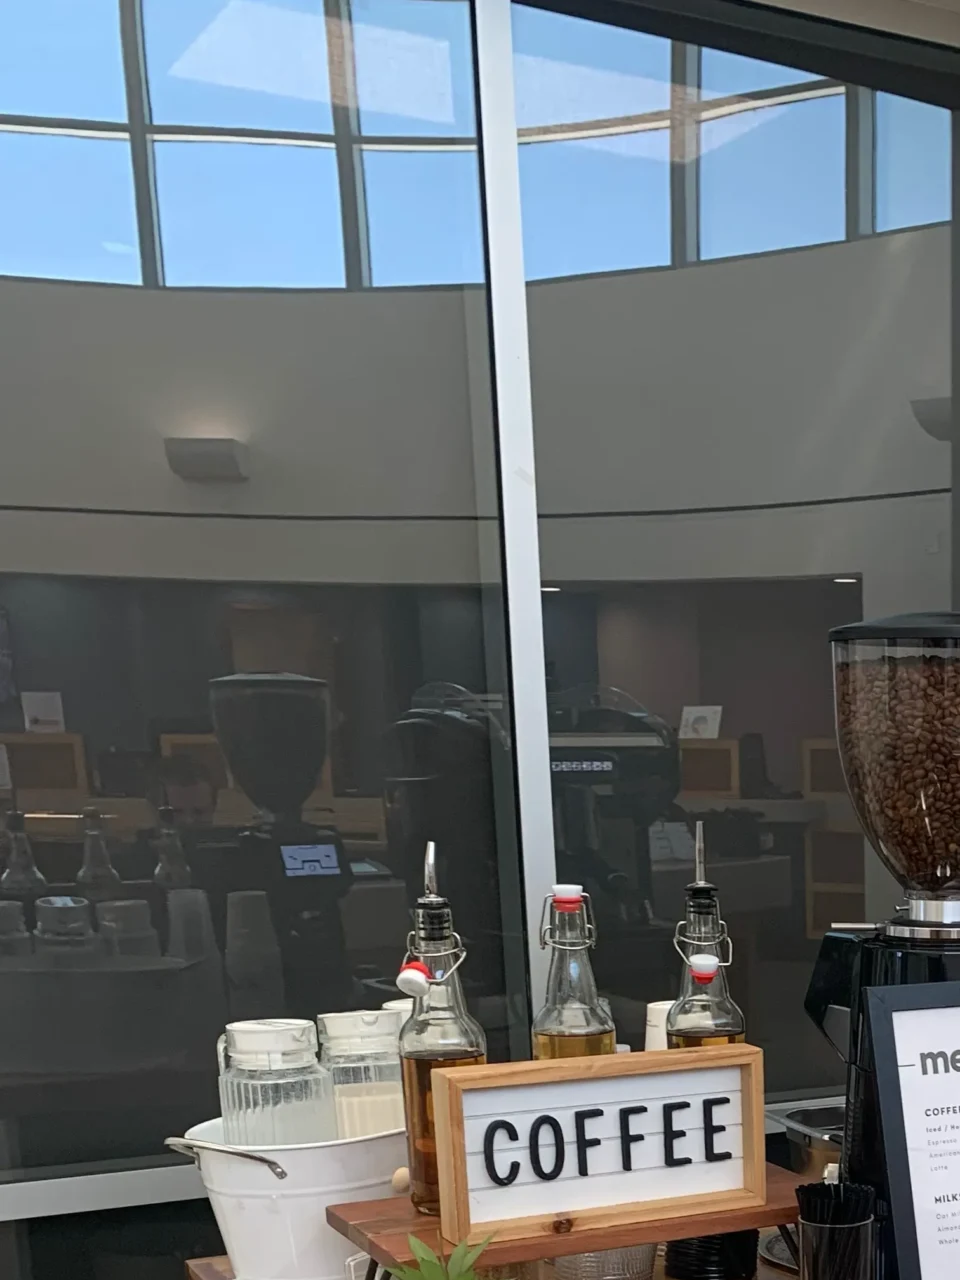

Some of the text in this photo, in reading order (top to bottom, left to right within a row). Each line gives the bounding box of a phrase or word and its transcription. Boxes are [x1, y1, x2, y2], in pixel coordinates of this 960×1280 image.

[925, 1125, 942, 1134] Iced
[483, 1096, 733, 1187] COFFEE
[927, 1138, 958, 1147] Espresso
